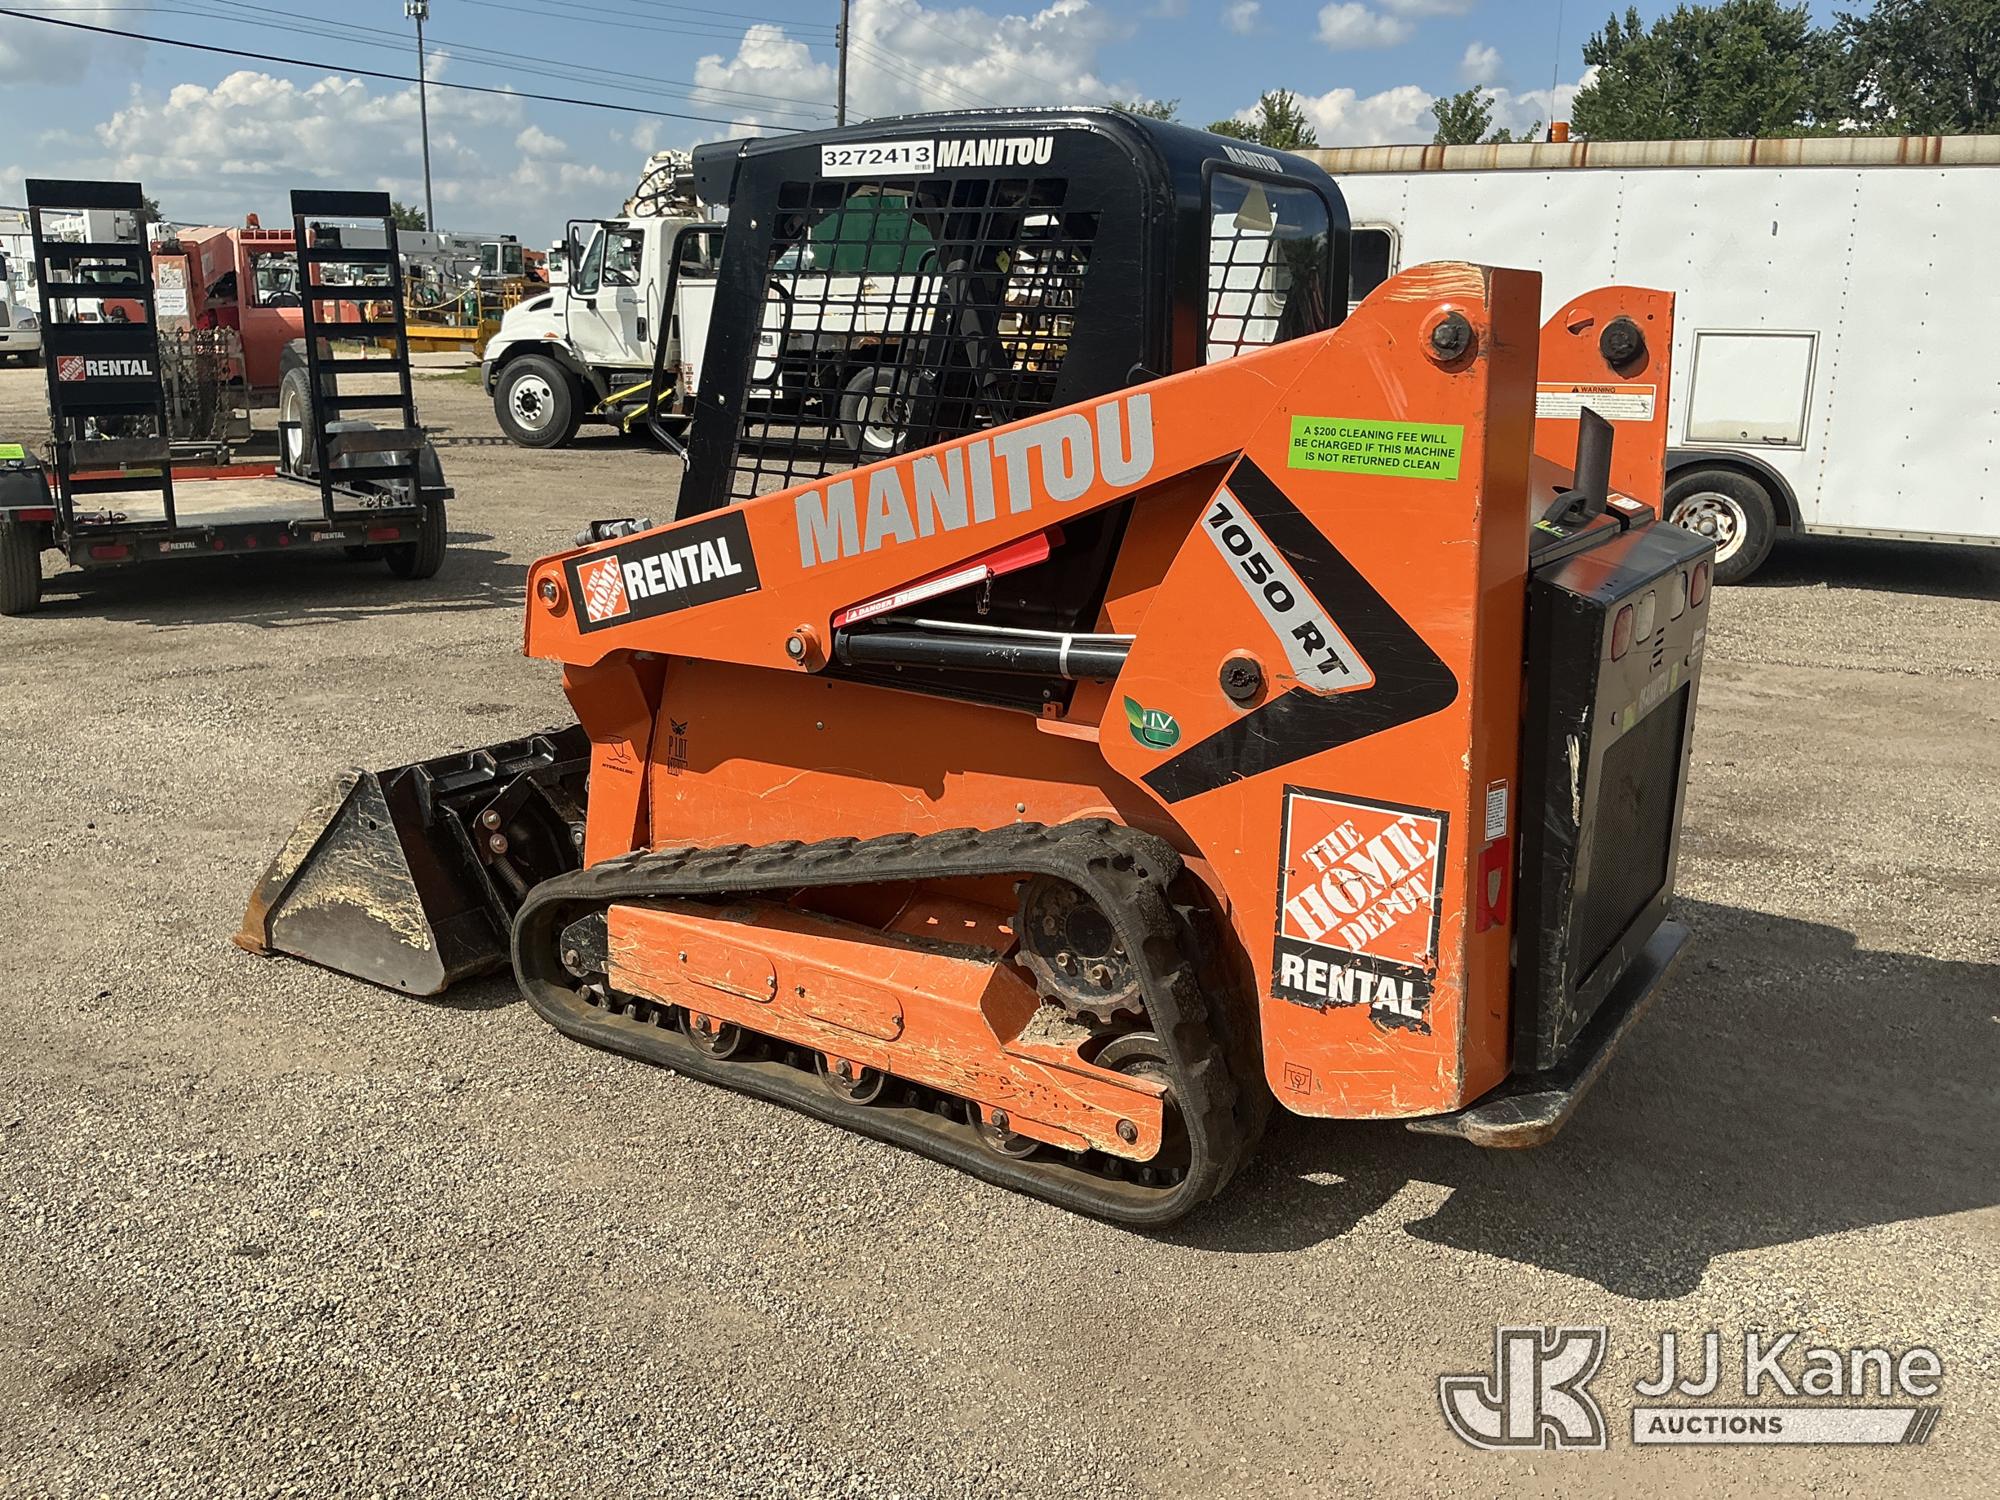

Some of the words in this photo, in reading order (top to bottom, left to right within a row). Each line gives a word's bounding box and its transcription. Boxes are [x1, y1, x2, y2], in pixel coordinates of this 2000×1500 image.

[823, 146, 931, 167] 3272413
[936, 137, 1055, 168] MANITOU
[1221, 145, 1284, 173] MANITOU
[85, 360, 153, 376] RENTAL
[1581, 386, 1616, 394] WARNING
[1294, 438, 1308, 448] BE
[1311, 439, 1363, 451] CHARGED
[1365, 442, 1375, 452] IF
[1378, 443, 1402, 454] THIS
[1404, 445, 1456, 458] MACHINE
[1304, 426, 1311, 435] A
[1313, 426, 1337, 437] $200
[1339, 429, 1394, 441] CLEANING
[1397, 432, 1418, 442] FEE
[1420, 433, 1448, 444] WILL
[1305, 452, 1315, 461] IS
[1318, 452, 1339, 463] NOT
[1341, 454, 1400, 467] RETURNED
[1402, 459, 1441, 470] CLEAN
[794, 392, 1155, 568] MANITOU
[171, 541, 198, 550] RENTAL
[321, 531, 347, 540] RENTAL
[586, 568, 602, 593] THE
[622, 536, 743, 601] RENTAL
[587, 558, 619, 621] HOME
[601, 577, 624, 618] DEPOT
[1208, 502, 1296, 613] 1050
[1291, 620, 1351, 676] RT
[858, 598, 893, 616] DANGER
[1301, 819, 1365, 872] THE
[1285, 815, 1436, 942] HOME
[1338, 872, 1434, 950] DEPOT
[1280, 952, 1424, 1020] RENTAL
